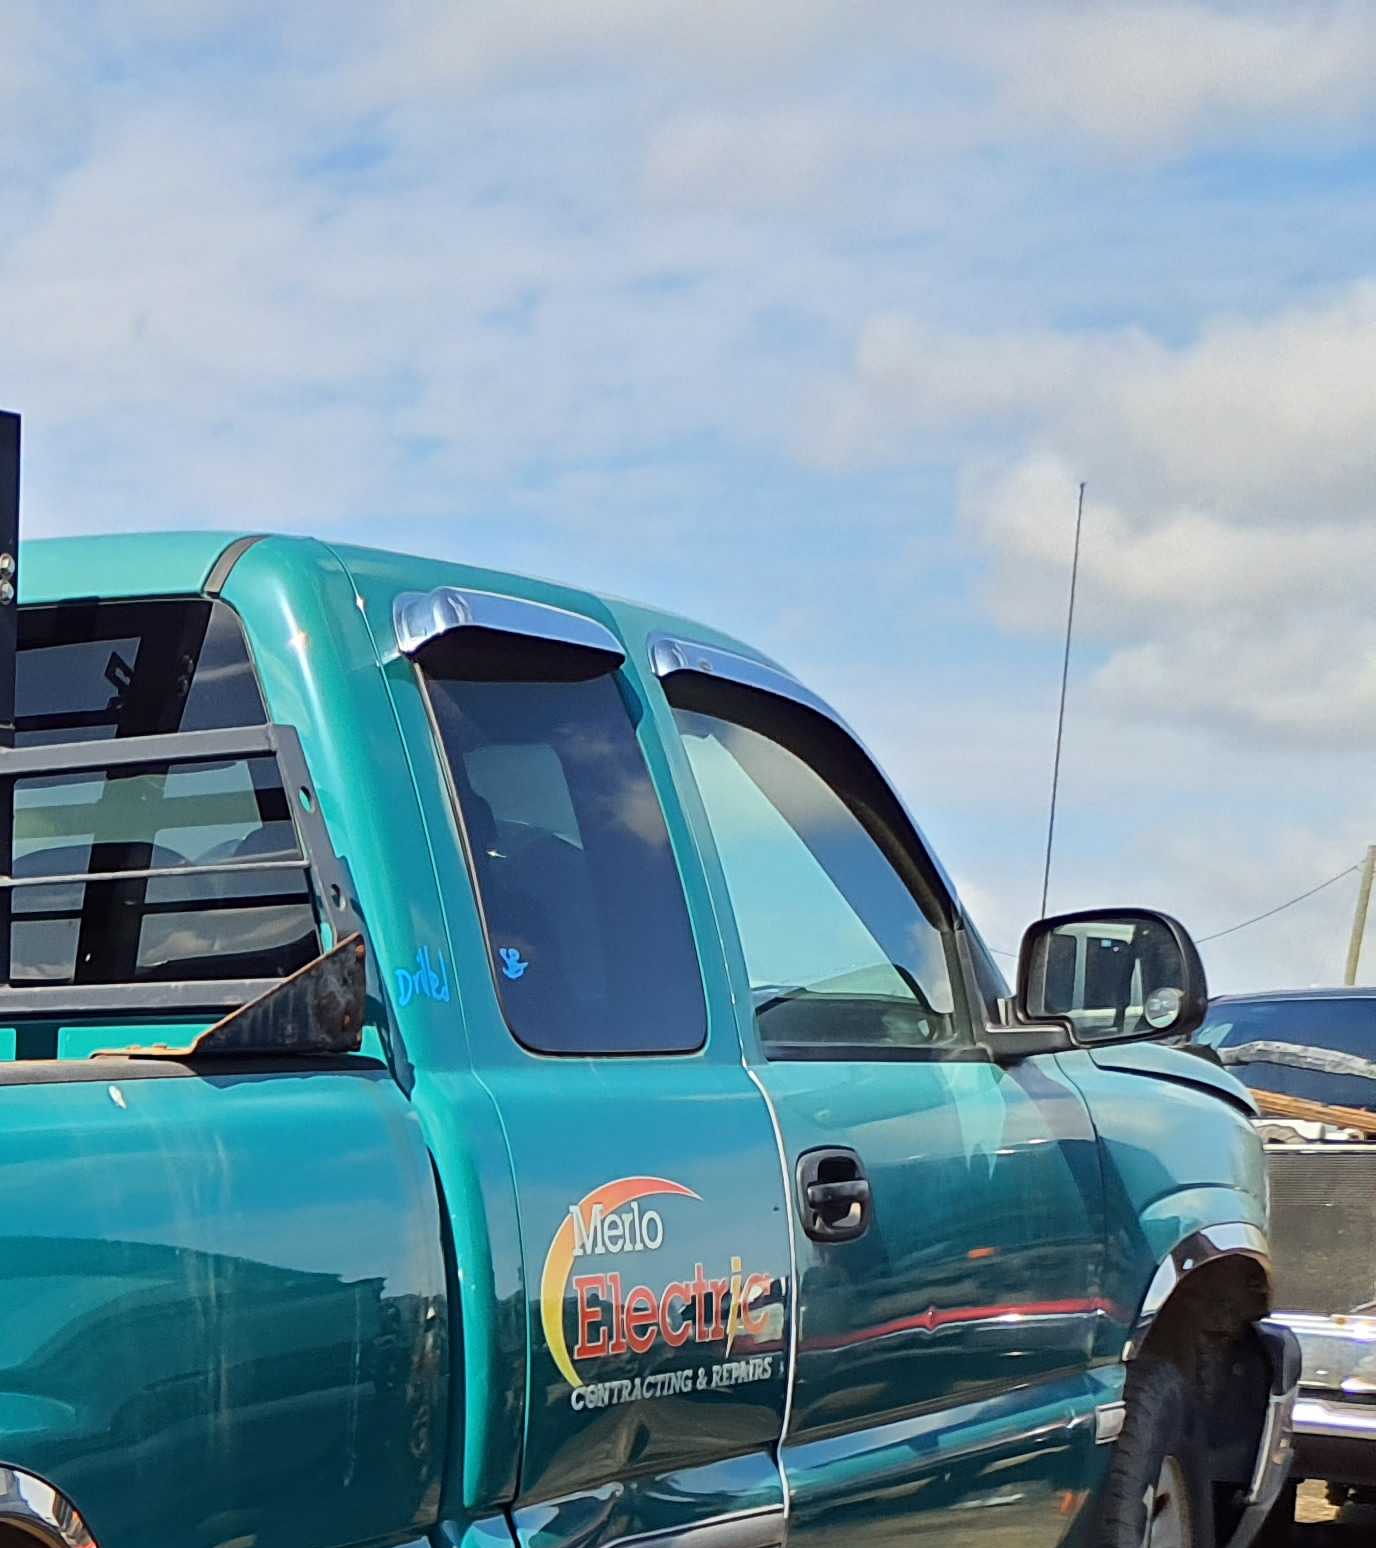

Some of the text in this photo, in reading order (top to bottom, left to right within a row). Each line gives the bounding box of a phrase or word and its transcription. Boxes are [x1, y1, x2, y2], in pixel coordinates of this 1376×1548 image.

[568, 1201, 664, 1257] Merlo
[572, 1255, 774, 1360] Electric
[570, 1356, 774, 1411] CONTRACTING & REPAIRS
